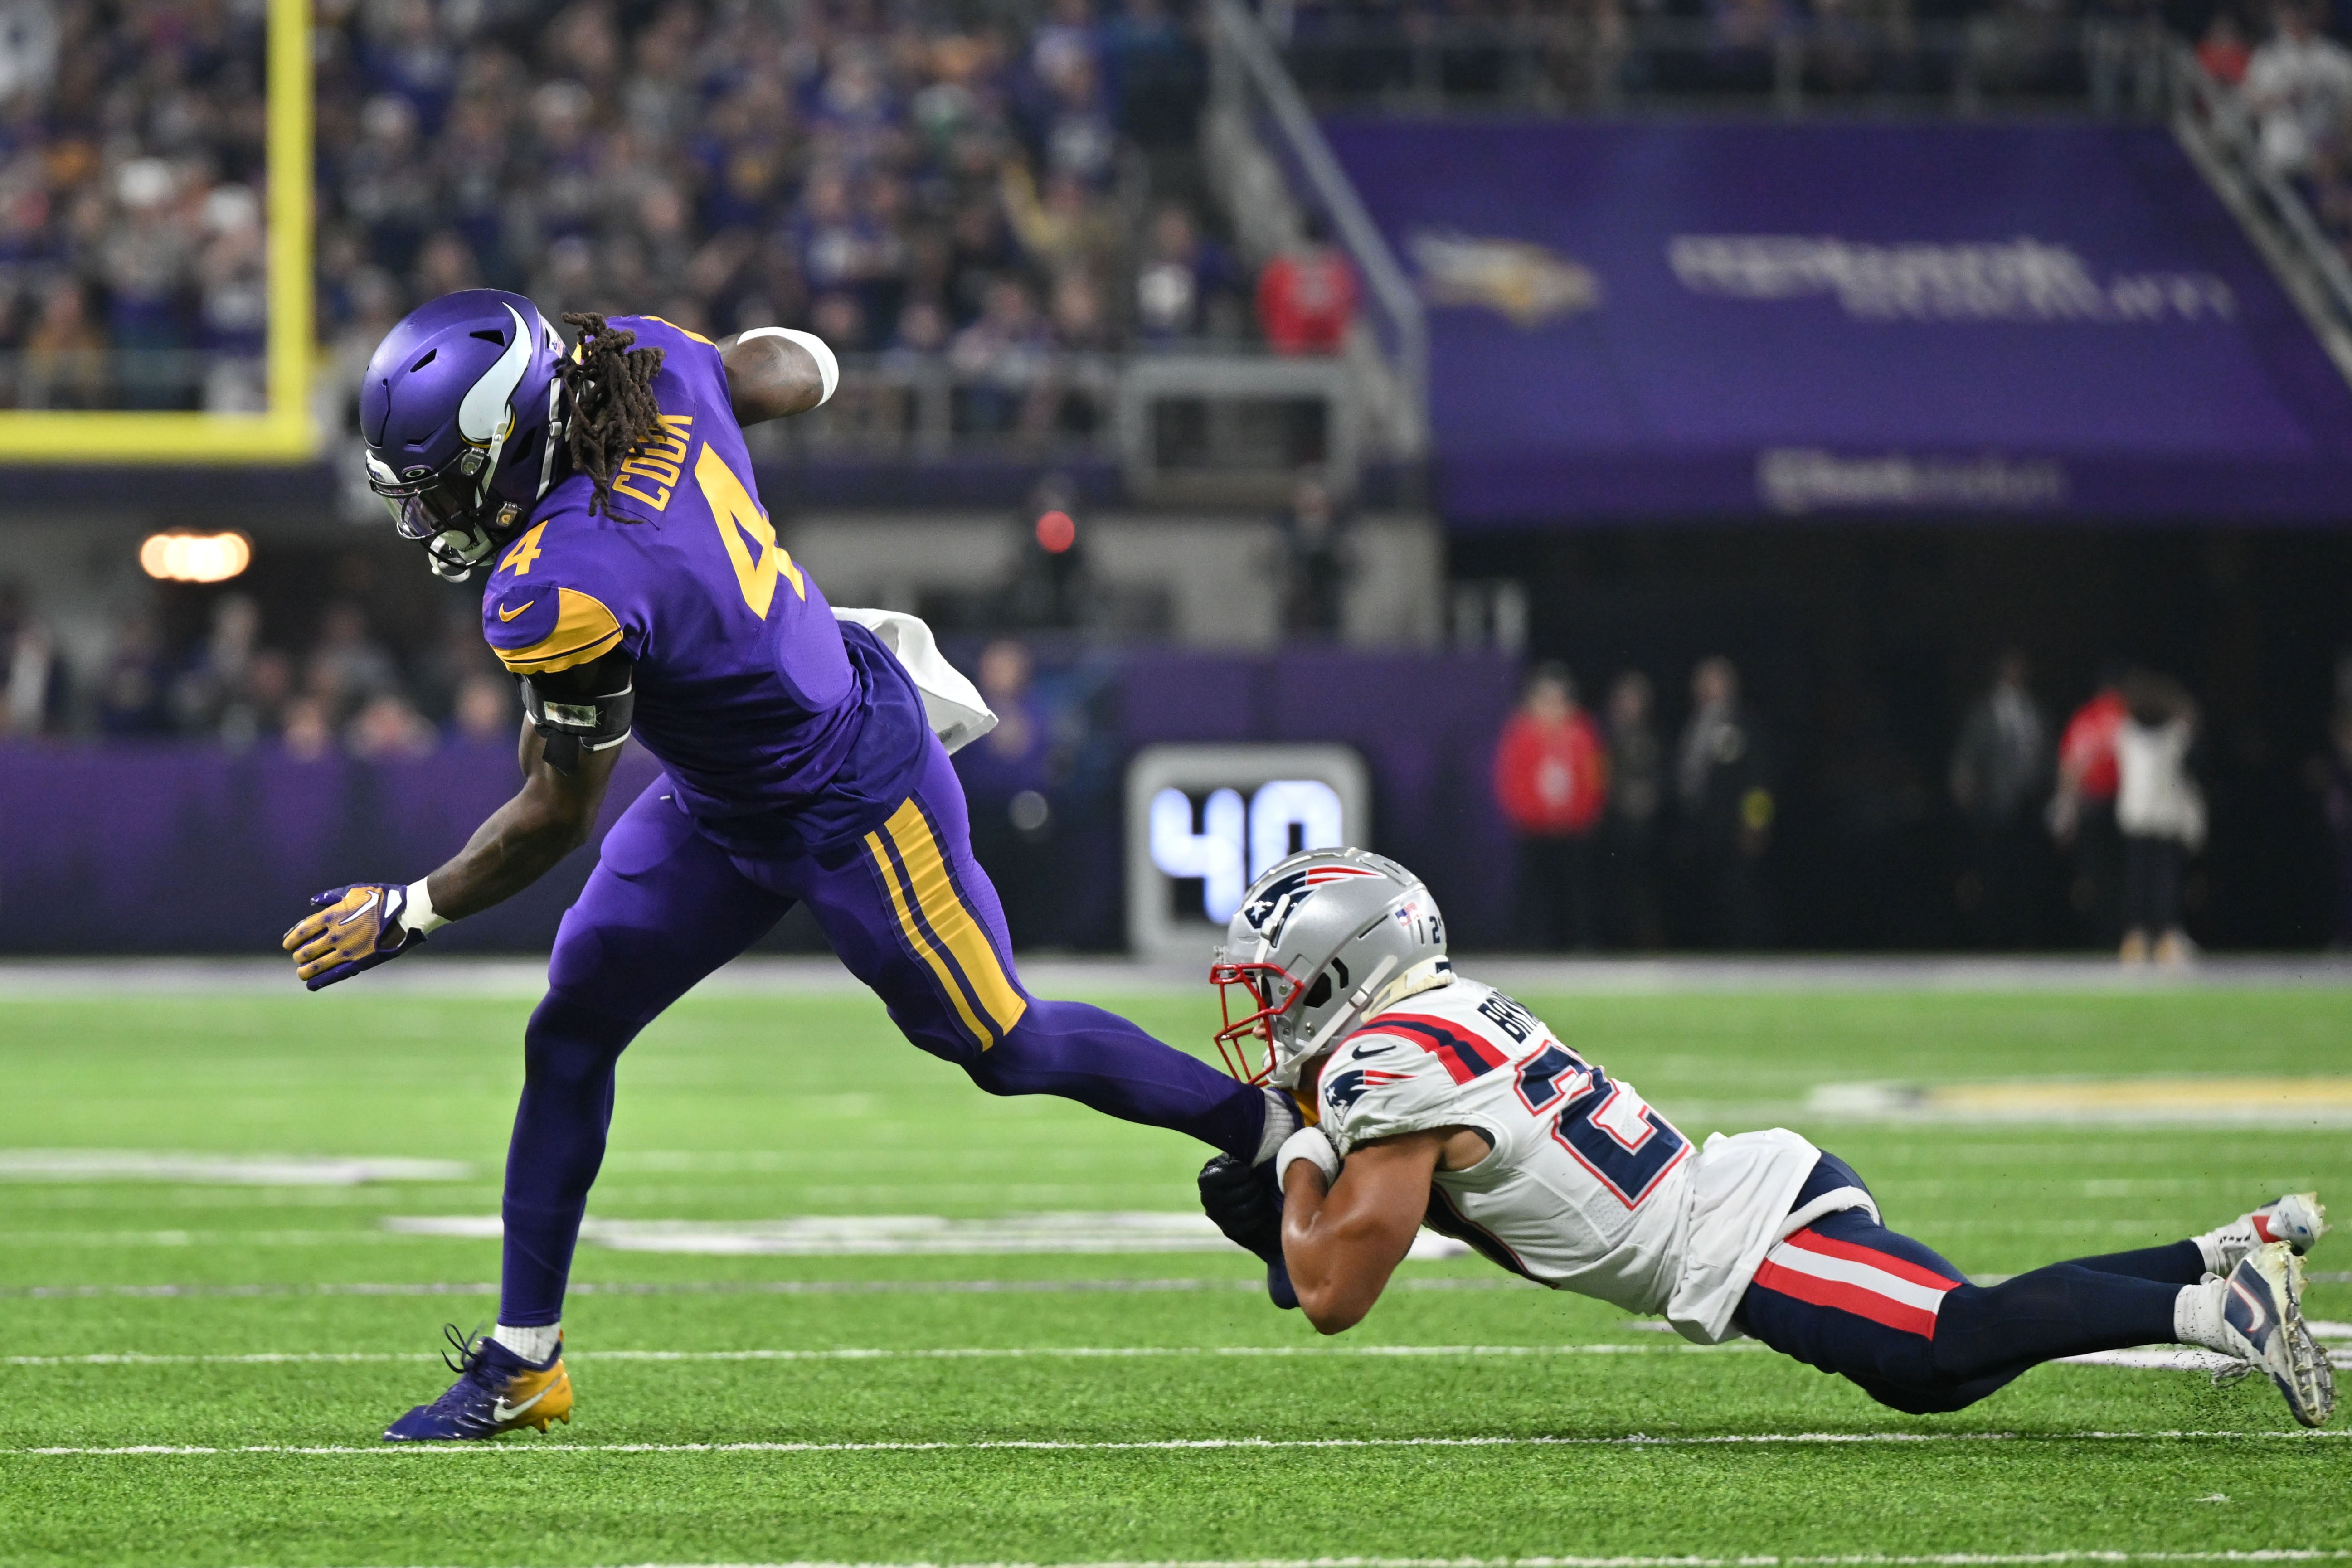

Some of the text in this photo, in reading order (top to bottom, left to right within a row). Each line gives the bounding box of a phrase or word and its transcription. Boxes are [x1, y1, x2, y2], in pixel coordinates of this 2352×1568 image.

[498, 520, 548, 576] 4
[694, 440, 805, 621] 4
[1150, 781, 1342, 925] 40
[1429, 916, 1442, 944] 2
